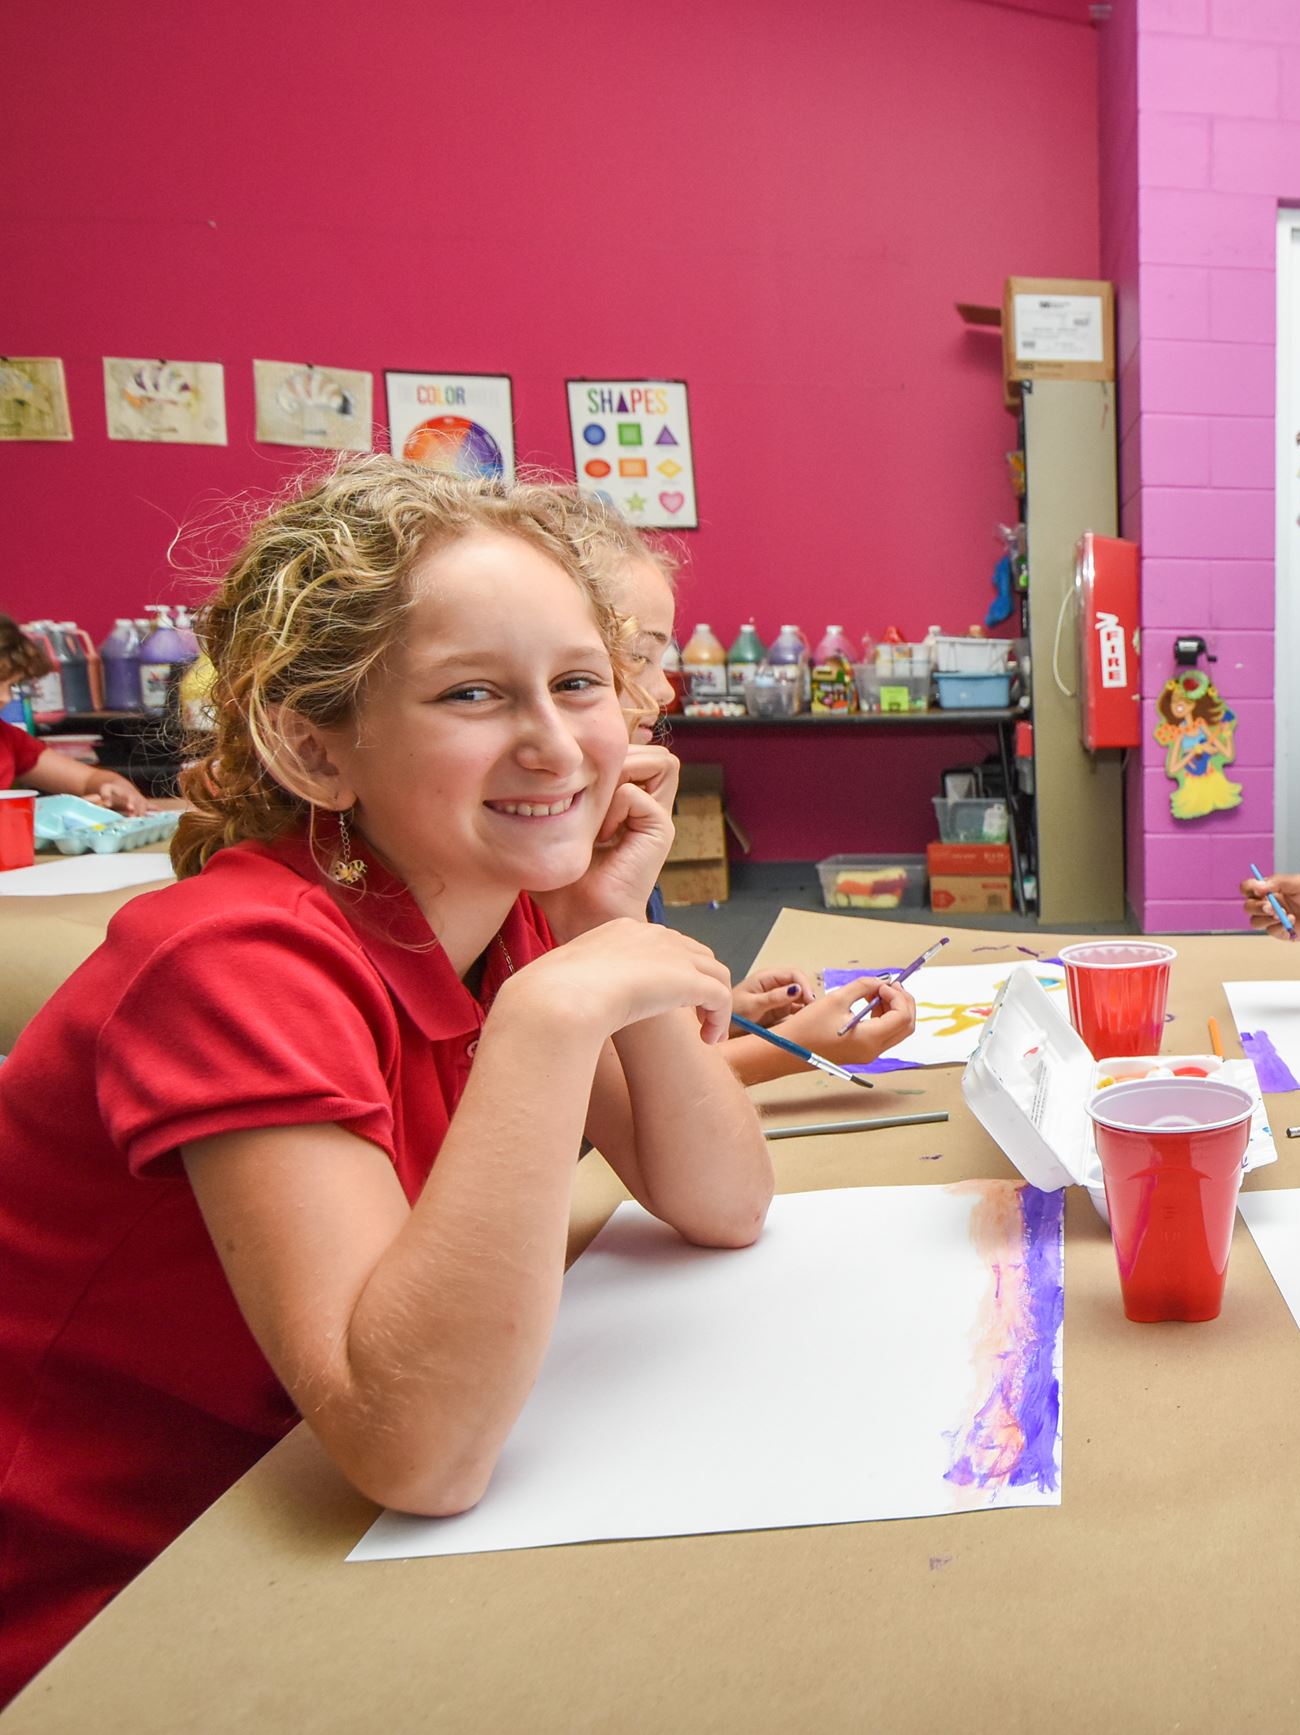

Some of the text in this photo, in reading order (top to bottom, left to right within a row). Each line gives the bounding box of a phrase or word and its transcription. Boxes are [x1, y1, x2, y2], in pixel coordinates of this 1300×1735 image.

[416, 383, 466, 405] COLOR
[587, 387, 669, 416] SHAPES
[1106, 631, 1120, 681] FIRE
